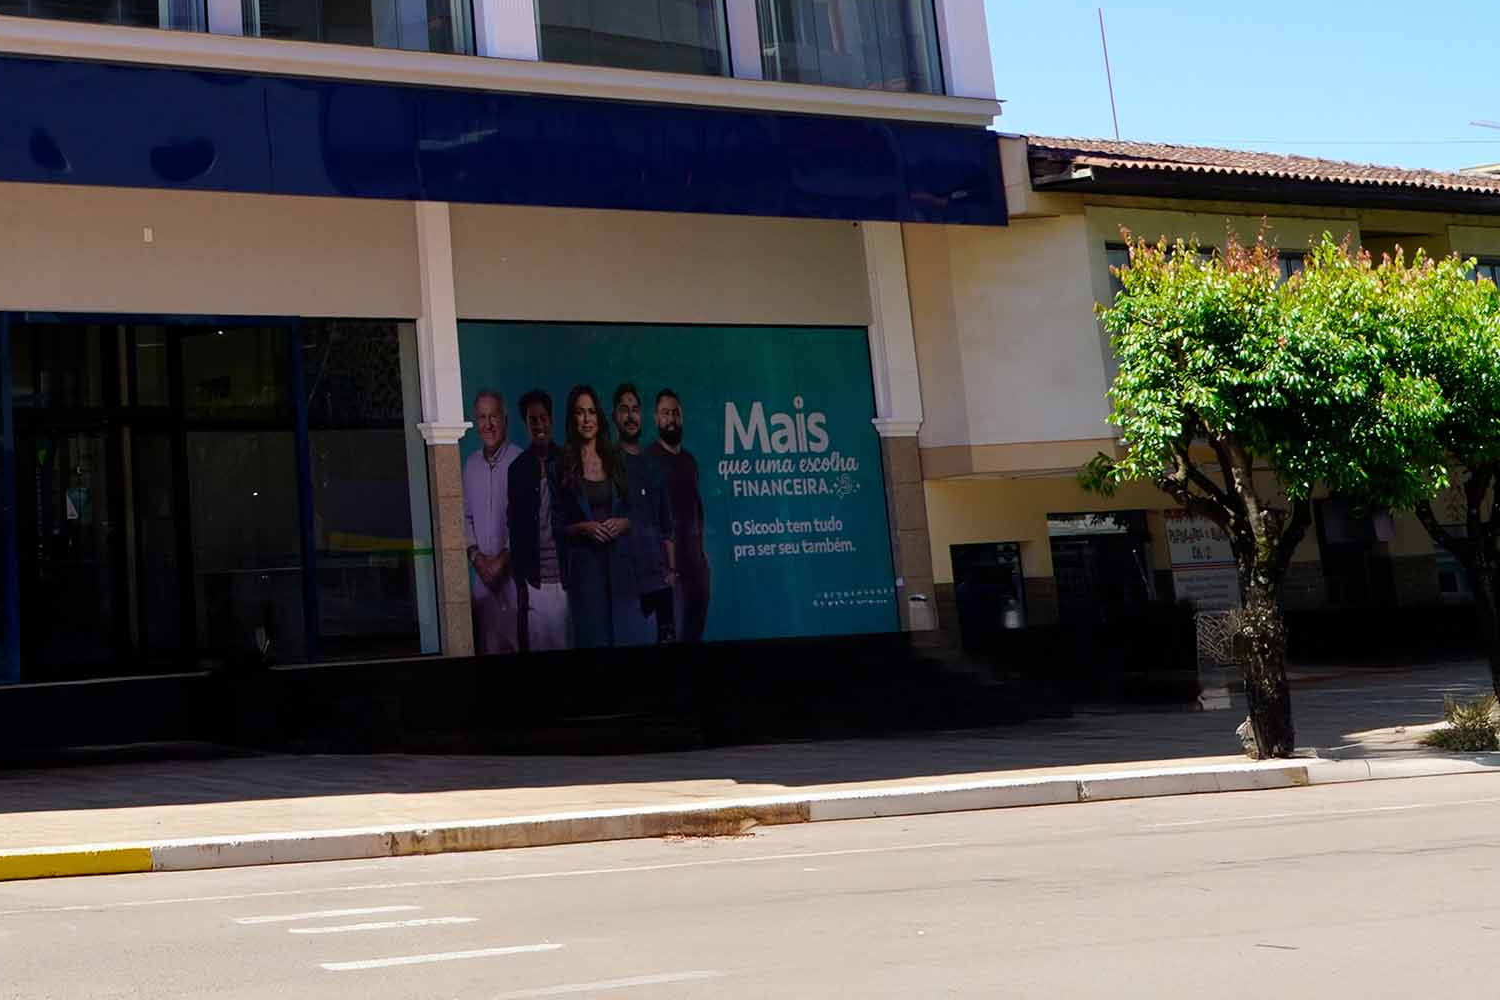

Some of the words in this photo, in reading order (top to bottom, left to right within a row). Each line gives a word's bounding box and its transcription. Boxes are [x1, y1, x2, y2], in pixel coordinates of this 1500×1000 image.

[724, 396, 829, 454] Mais
[718, 458, 752, 480] que
[755, 458, 796, 473] uma
[799, 451, 859, 473] escolha
[733, 478, 834, 497] FINANCEIRA.
[732, 520, 742, 536] O
[744, 517, 785, 535] Sicoob
[786, 519, 812, 533] tem
[813, 515, 843, 532] tudo
[734, 544, 756, 562] pra
[757, 542, 776, 556] ser
[778, 541, 800, 555] seu
[801, 537, 857, 554] também.
